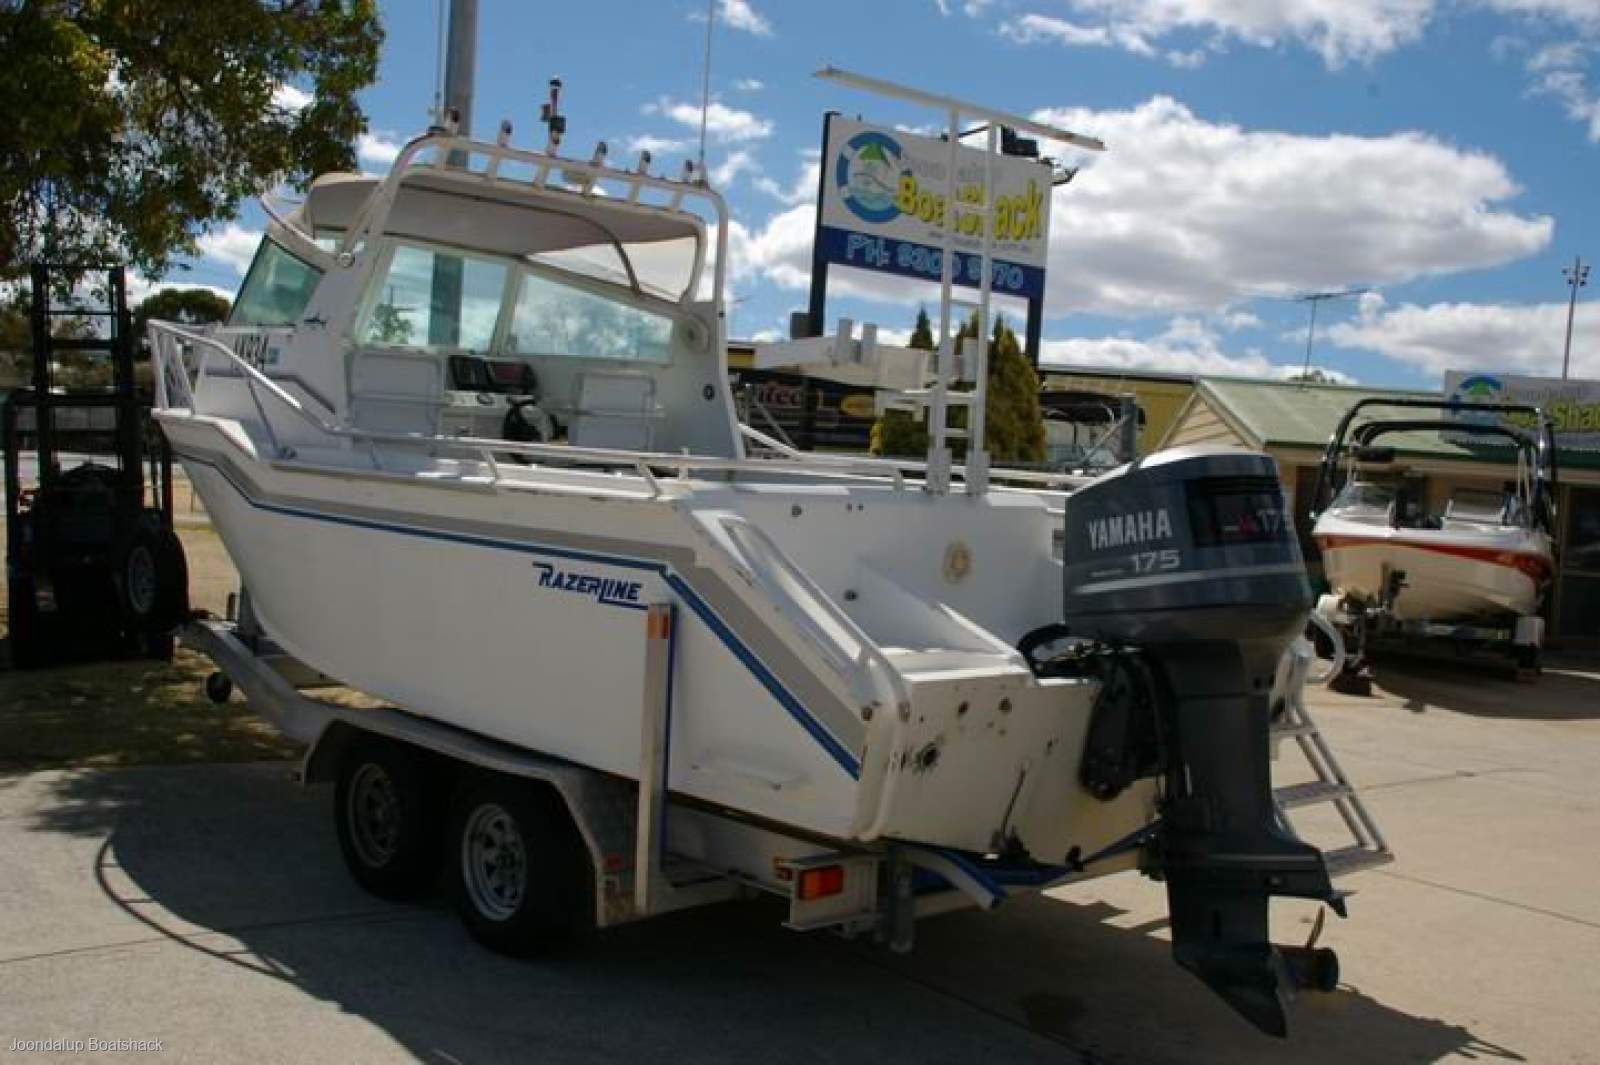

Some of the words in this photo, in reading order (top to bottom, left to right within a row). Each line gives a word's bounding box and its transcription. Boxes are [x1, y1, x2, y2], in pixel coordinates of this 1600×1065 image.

[1088, 508, 1173, 551] YAMAHA
[1129, 549, 1181, 574] 175
[532, 561, 649, 610] RAZERLINE
